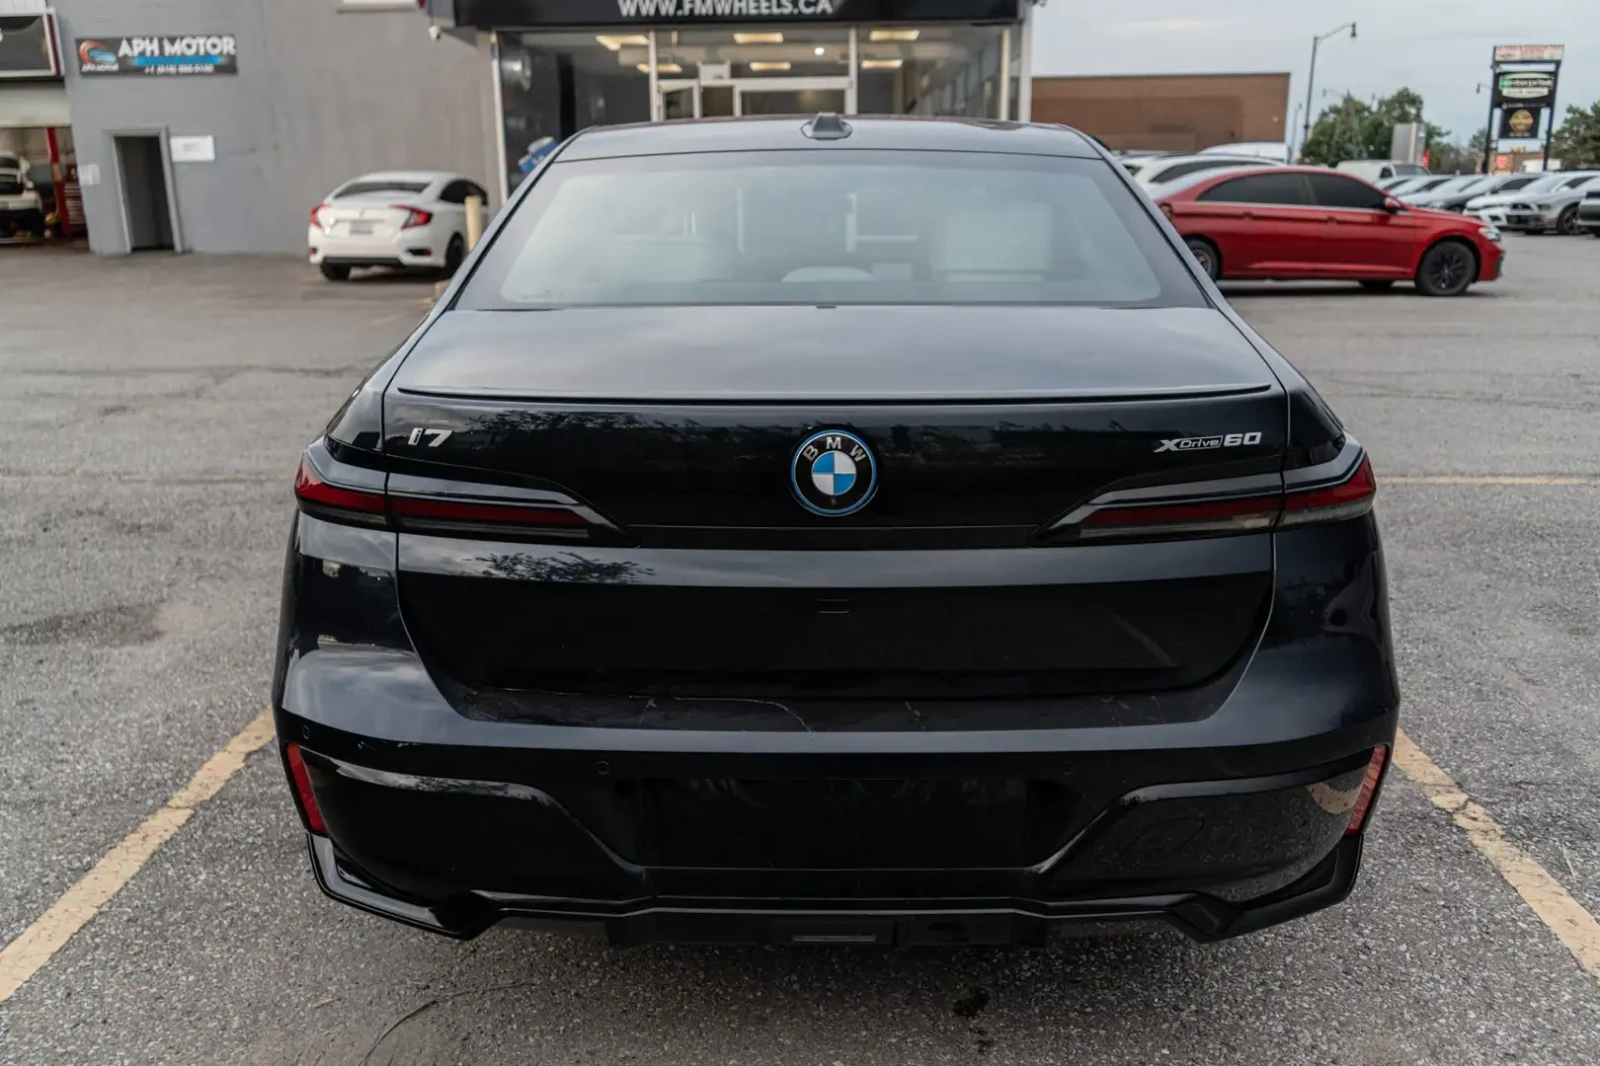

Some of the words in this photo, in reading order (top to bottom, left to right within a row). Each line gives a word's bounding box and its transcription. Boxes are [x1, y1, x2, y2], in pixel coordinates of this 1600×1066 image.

[618, 0, 833, 16] WWW.FMWHEELS.CA
[118, 37, 160, 57] APH
[164, 36, 236, 56] MOTOR
[408, 427, 453, 447] i7
[802, 436, 867, 462] BMW
